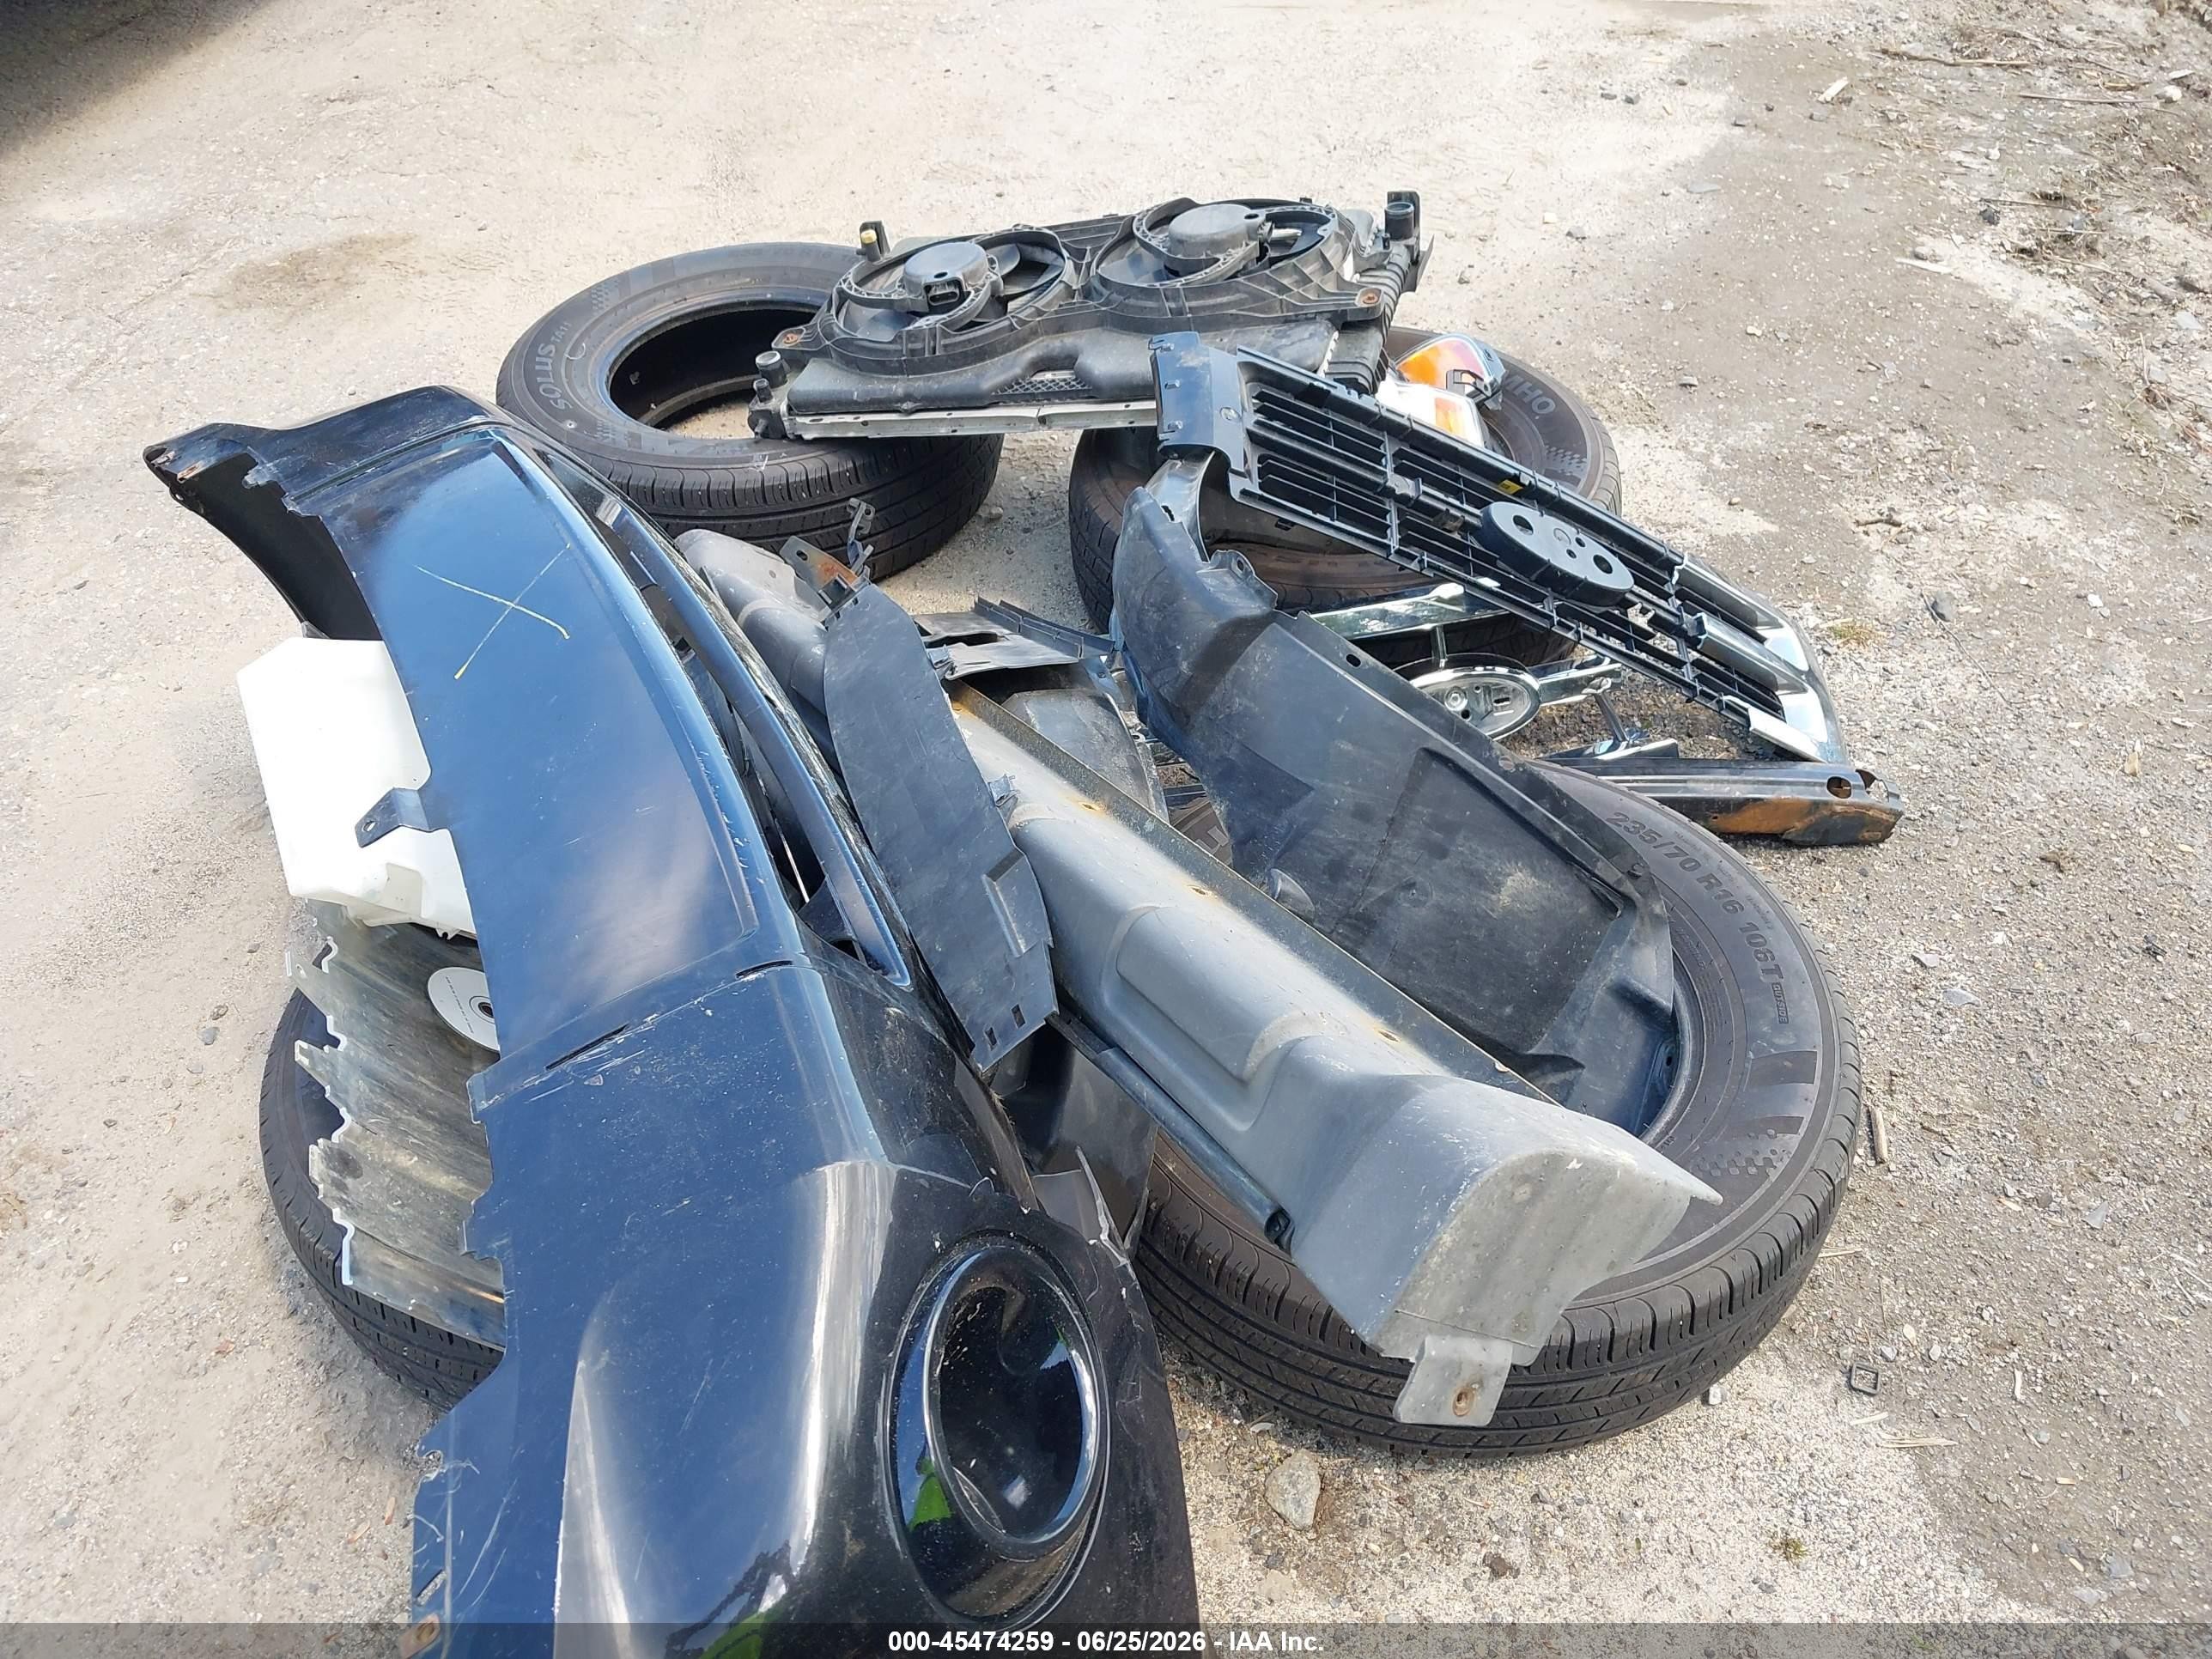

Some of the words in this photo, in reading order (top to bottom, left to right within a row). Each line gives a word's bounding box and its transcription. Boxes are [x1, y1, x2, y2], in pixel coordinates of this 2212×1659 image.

[535, 343, 574, 410] SOLUS
[1605, 811, 1701, 872] 235/70
[1696, 872, 1745, 915] R16
[1739, 921, 1784, 980] 106T
